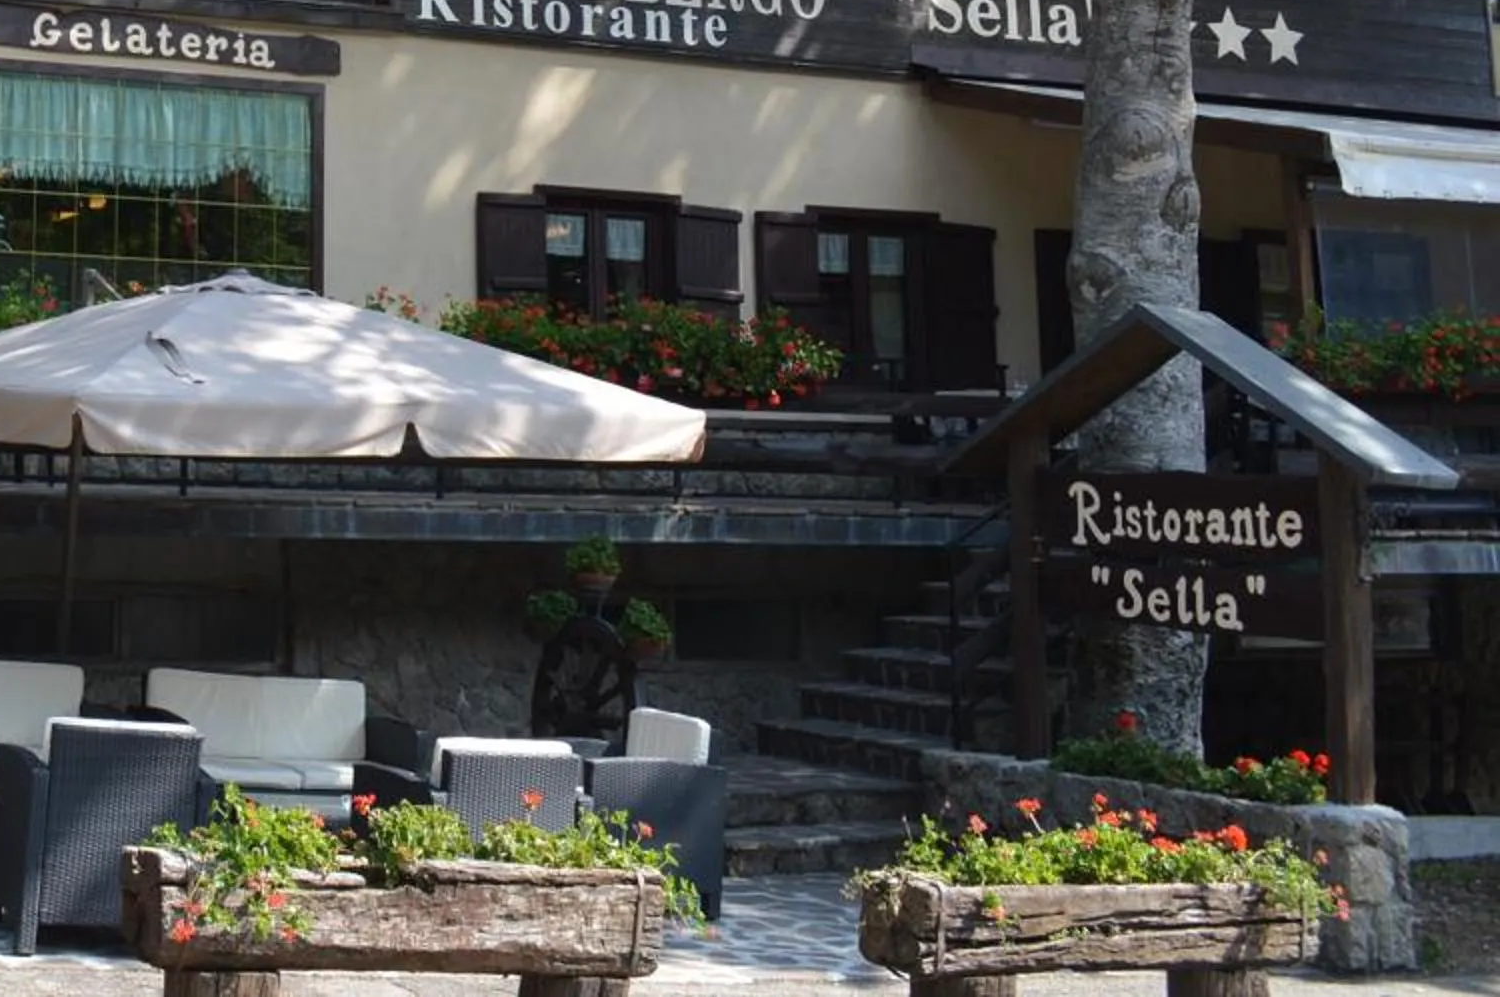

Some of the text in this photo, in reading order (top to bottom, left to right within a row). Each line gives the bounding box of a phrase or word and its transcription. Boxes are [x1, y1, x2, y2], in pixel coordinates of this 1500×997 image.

[30, 11, 276, 70] Gelateria
[1068, 480, 1304, 548] Ristorante
[1090, 565, 1267, 633] "Sella"
